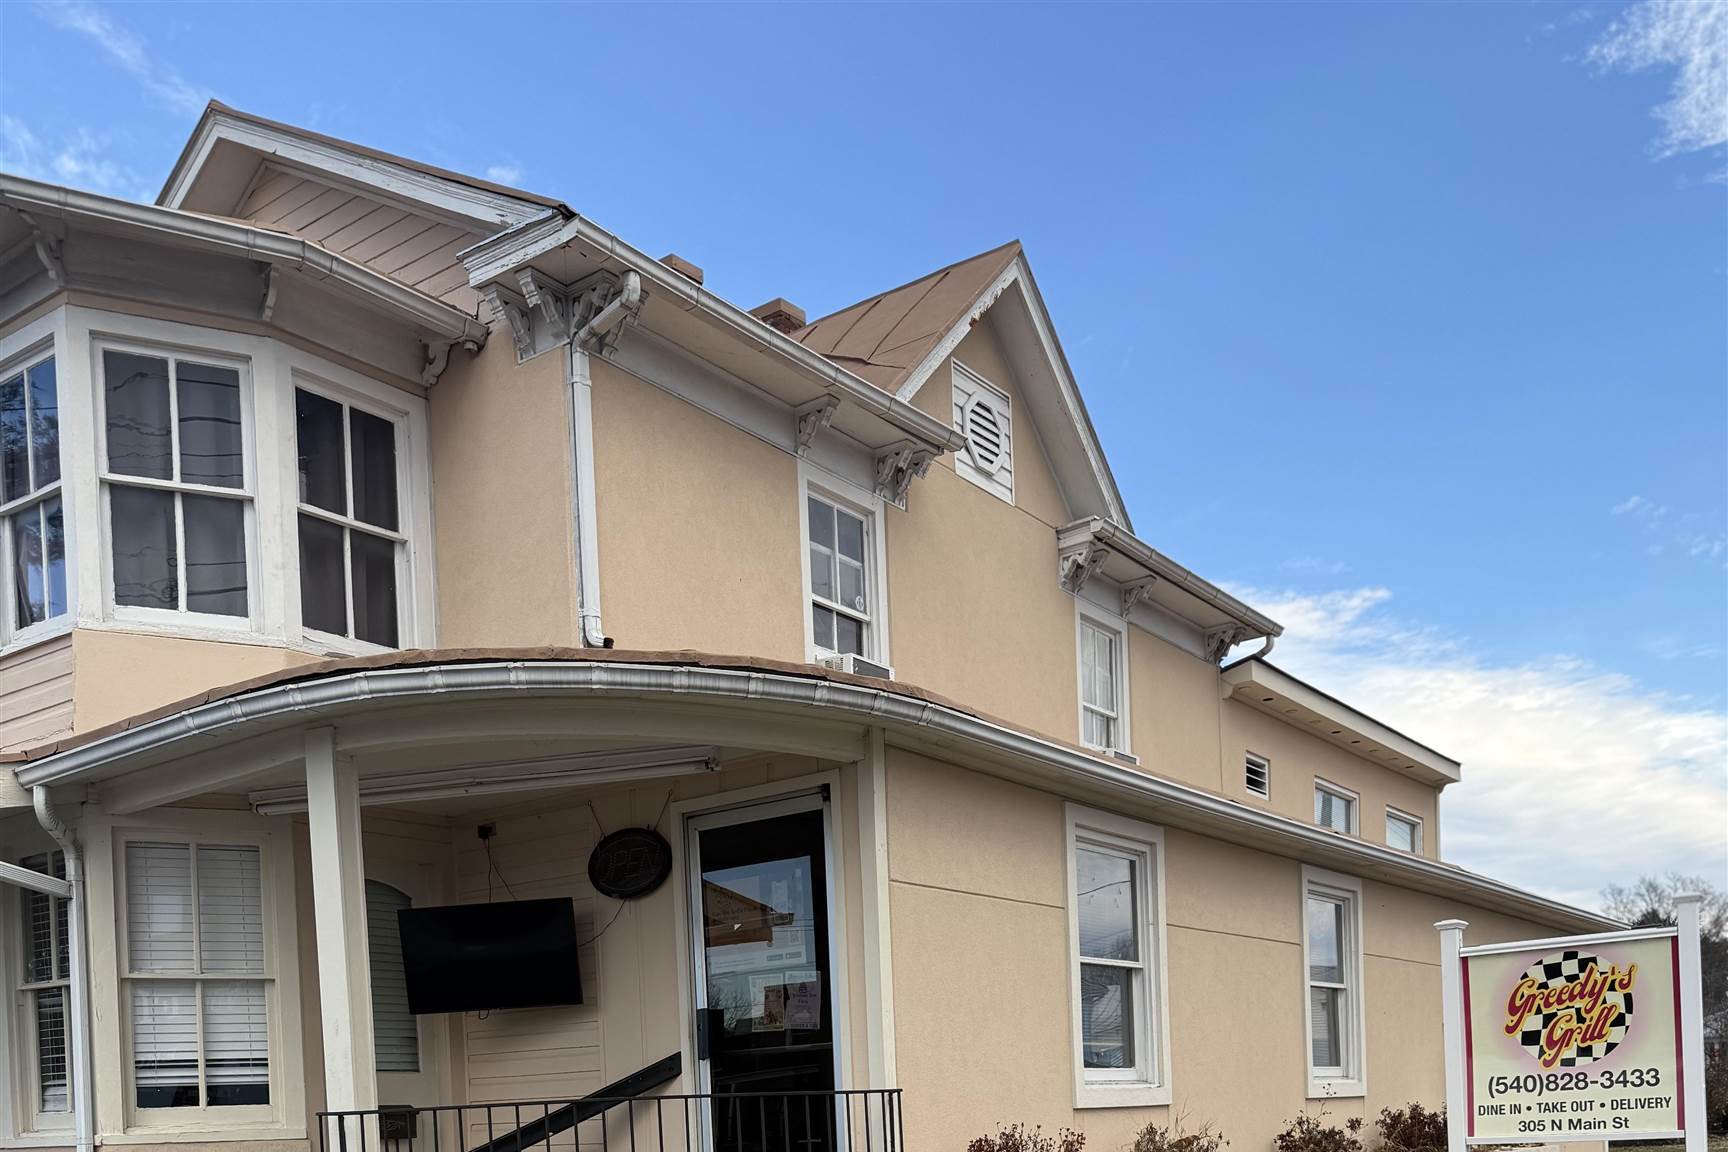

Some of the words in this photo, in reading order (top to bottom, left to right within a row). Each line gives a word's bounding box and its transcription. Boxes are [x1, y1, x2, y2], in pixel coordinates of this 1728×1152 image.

[597, 845, 659, 881] OPEN
[1504, 963, 1637, 1036] Greedy's
[1541, 1002, 1618, 1068] Grill
[1488, 1068, 1660, 1098] (540)828-3433
[1478, 1104, 1506, 1116] DINE
[1510, 1104, 1521, 1114] IN
[1537, 1102, 1567, 1113] TAKE
[1570, 1100, 1595, 1112] OUT
[1611, 1097, 1672, 1110] DELIVERY
[1518, 1120, 1546, 1132] 305
[1551, 1120, 1562, 1131] N
[1568, 1117, 1607, 1130] Main
[1612, 1116, 1629, 1128] St
